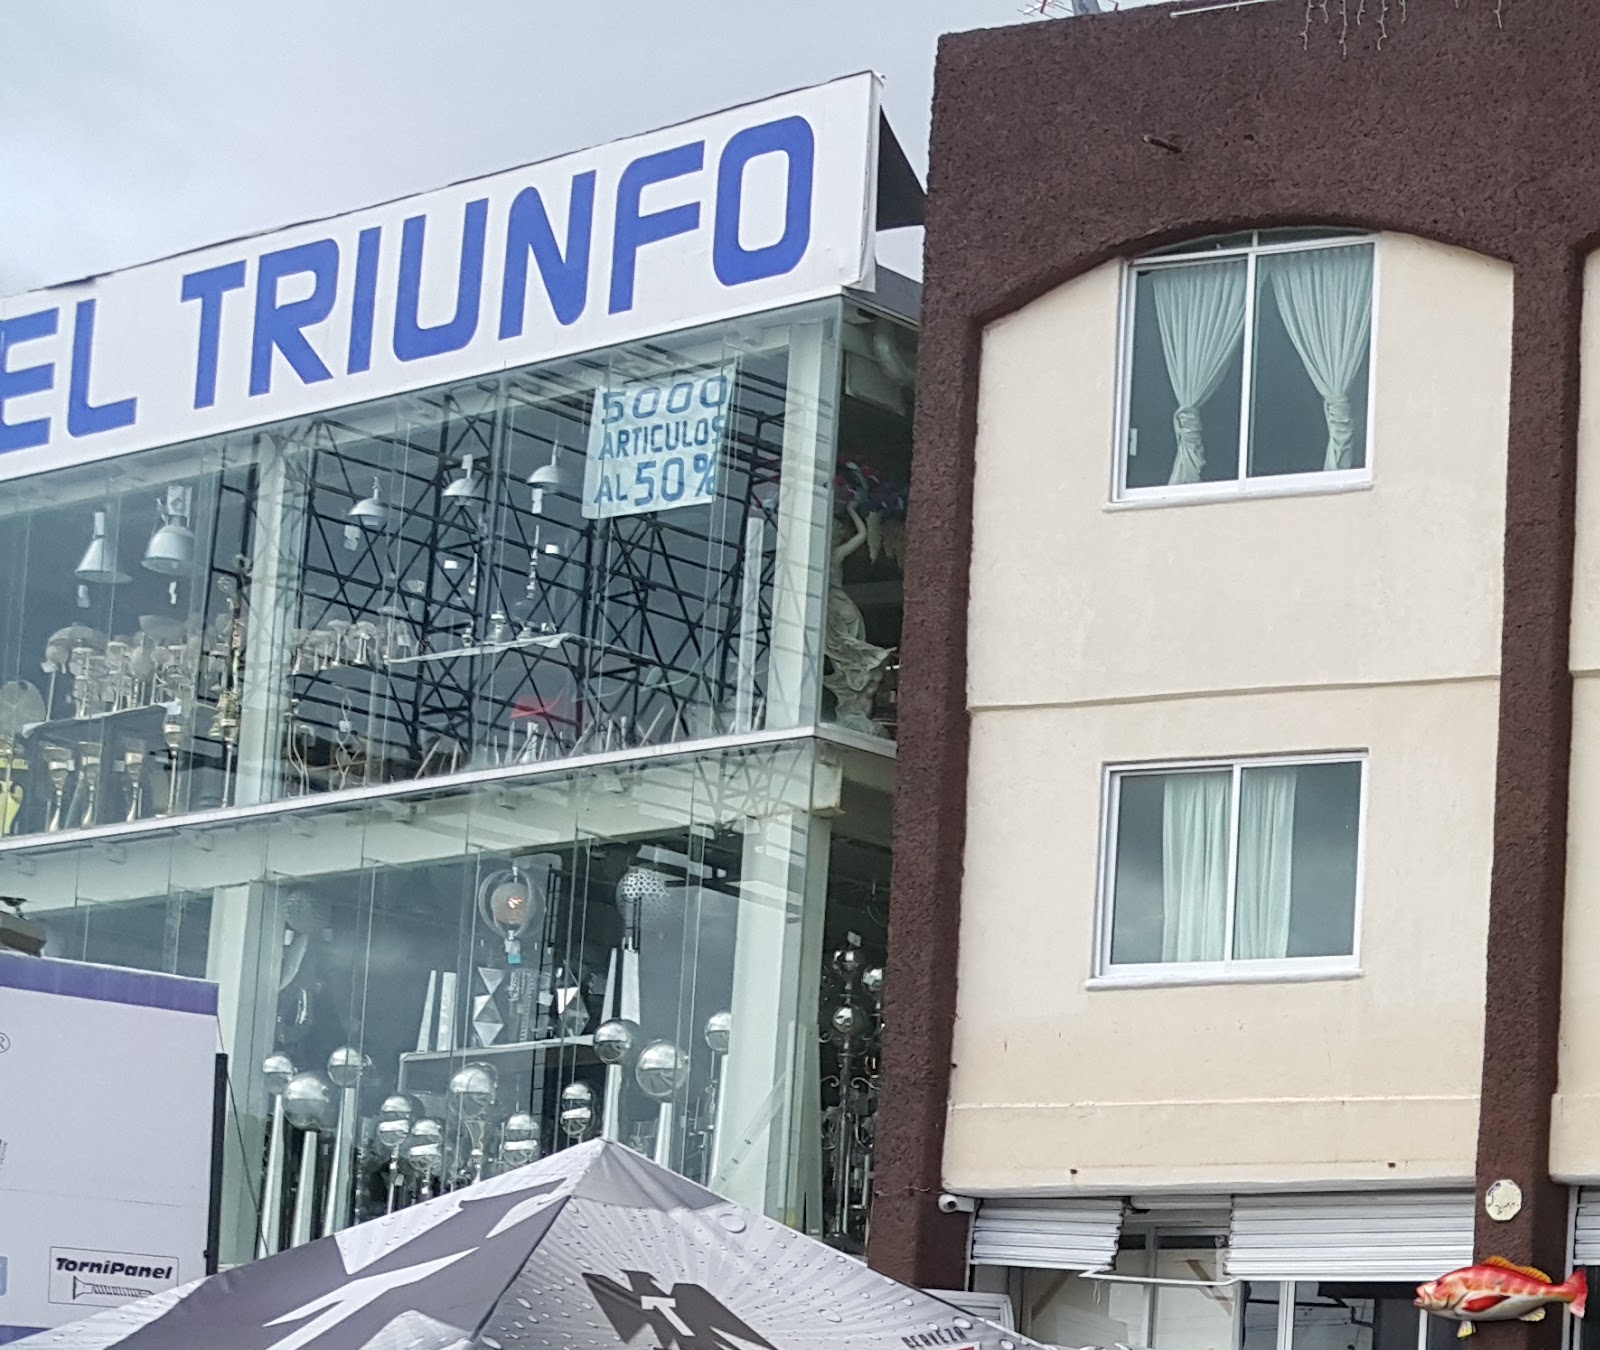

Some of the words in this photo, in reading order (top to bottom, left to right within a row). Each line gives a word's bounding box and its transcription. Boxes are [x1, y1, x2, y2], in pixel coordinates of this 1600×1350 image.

[0, 298, 138, 454] EL
[181, 115, 815, 410] TRIUNFO
[601, 375, 728, 425] 5000
[598, 415, 725, 460] ARTICULOS
[593, 474, 628, 503] AL
[634, 451, 716, 506] 50%
[55, 1257, 173, 1280] TorniPanel
[902, 1324, 965, 1350] CERVEZA
